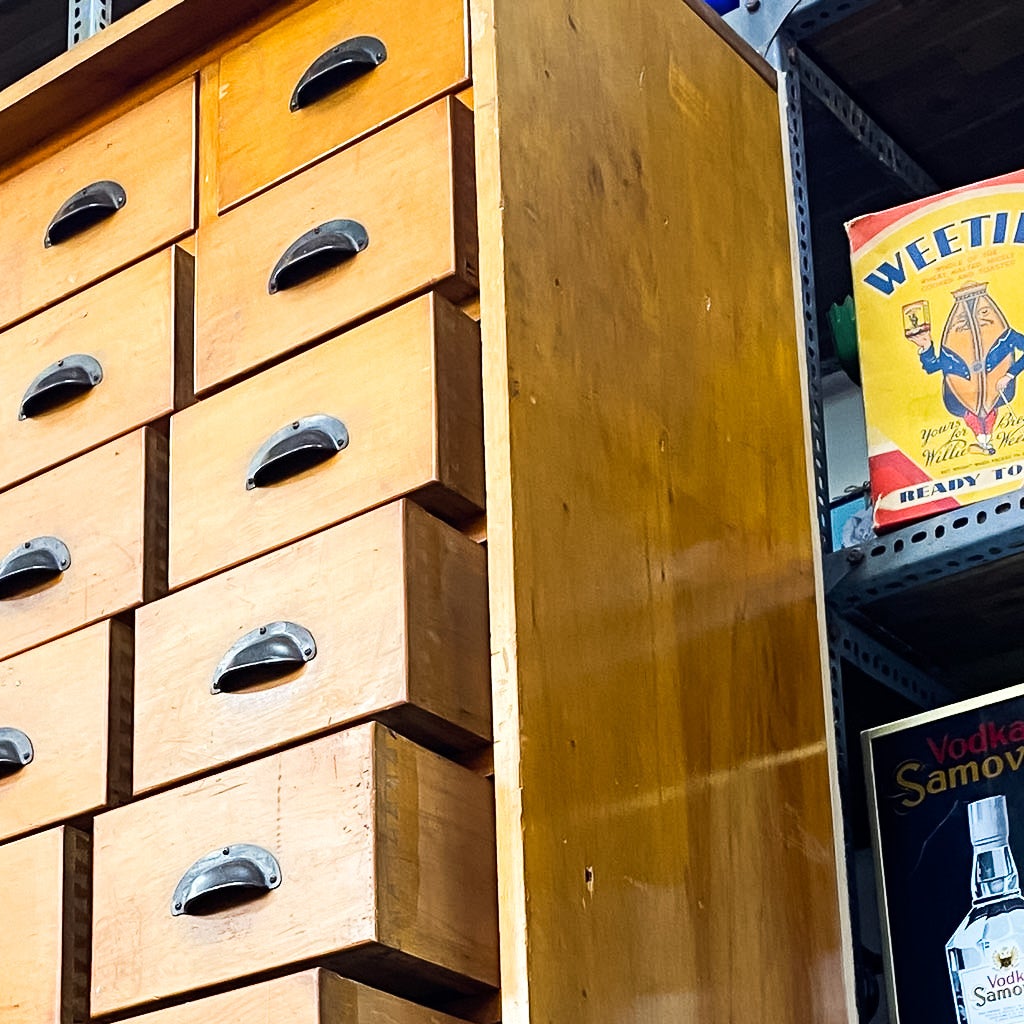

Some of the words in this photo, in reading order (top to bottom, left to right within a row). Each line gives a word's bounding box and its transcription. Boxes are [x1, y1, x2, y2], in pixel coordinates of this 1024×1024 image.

[920, 420, 961, 447] Yours
[949, 427, 967, 443] for
[922, 439, 968, 468] Willie
[900, 473, 981, 504] READY
[992, 464, 1023, 480] TO
[926, 720, 1024, 765] Vodka
[974, 984, 1024, 1007] Samo
